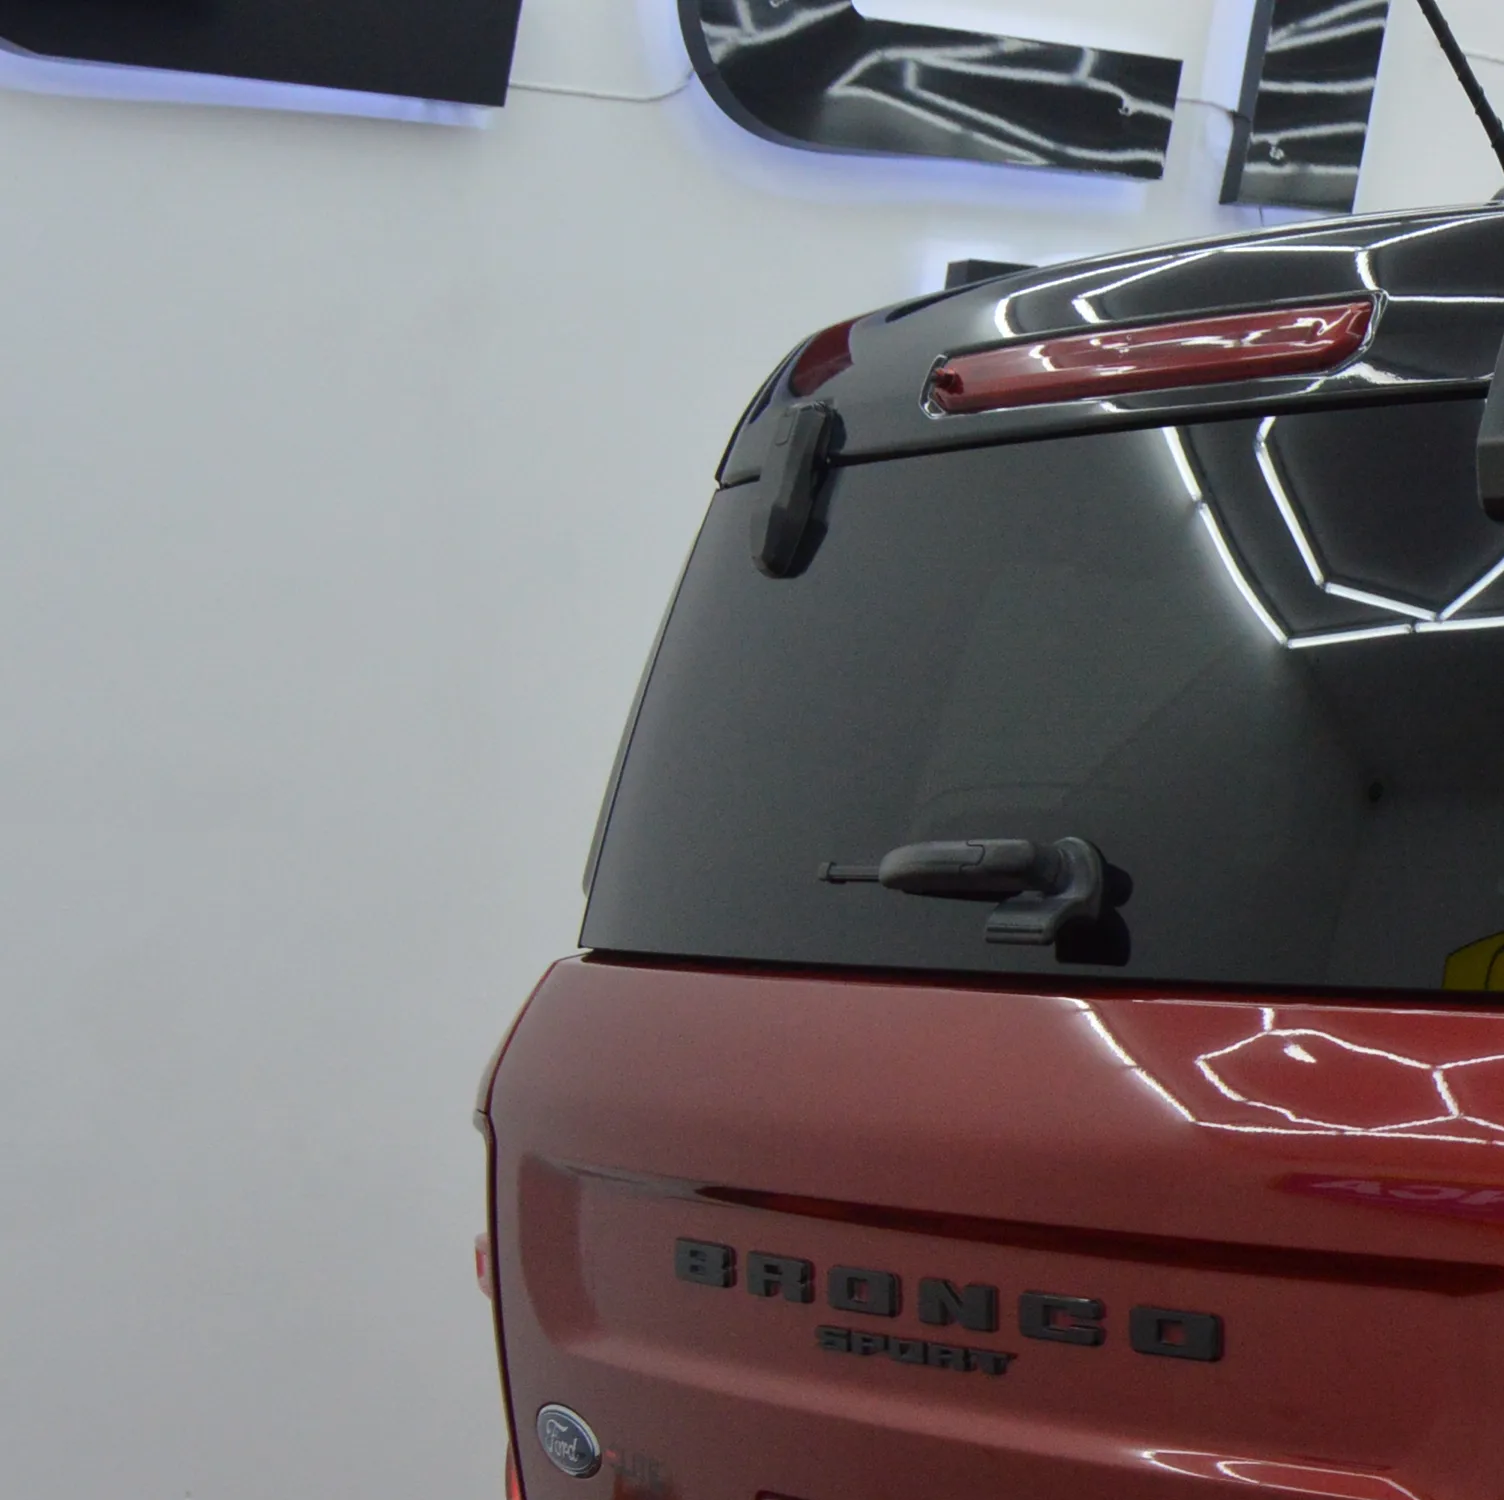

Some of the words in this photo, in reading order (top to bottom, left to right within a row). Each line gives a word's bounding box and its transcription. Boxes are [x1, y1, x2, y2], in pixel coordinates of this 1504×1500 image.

[673, 1236, 1226, 1363] BRONCO
[813, 1323, 1019, 1376] SPORT
[545, 1418, 581, 1463] Ford
